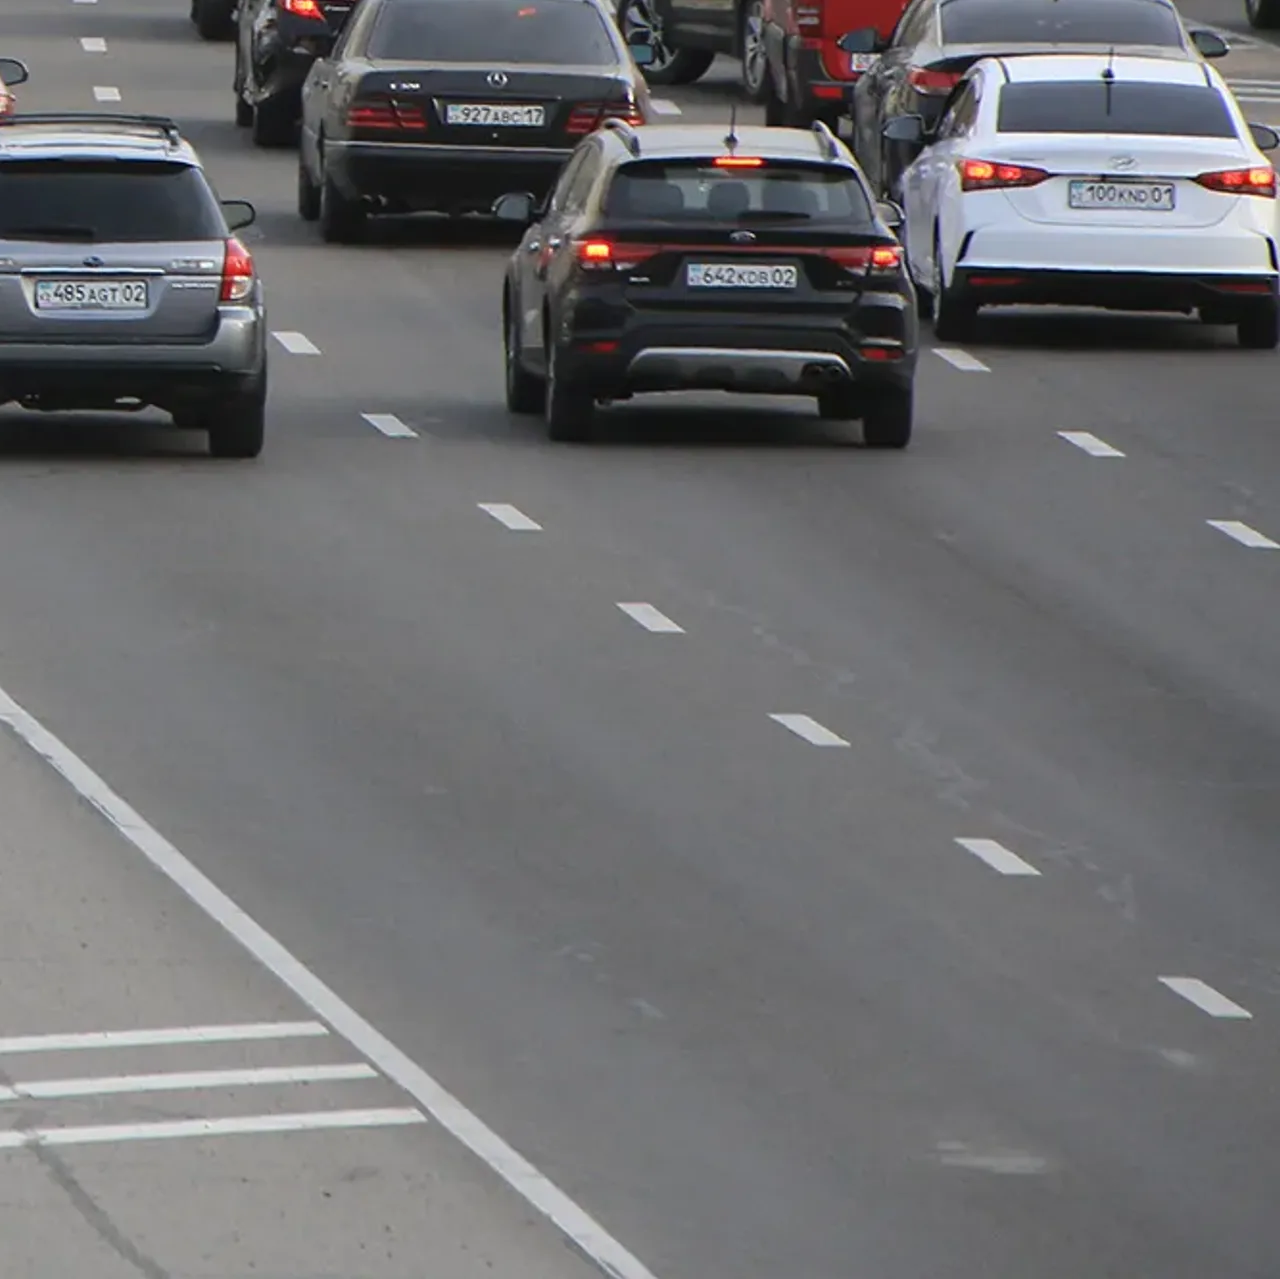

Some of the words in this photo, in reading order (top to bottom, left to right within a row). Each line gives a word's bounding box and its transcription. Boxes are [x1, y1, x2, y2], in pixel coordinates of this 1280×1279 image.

[461, 107, 490, 121] 927
[524, 107, 543, 123] 17
[1086, 185, 1116, 202] 100
[1151, 187, 1173, 203] 01
[702, 267, 735, 284] 642
[771, 268, 796, 286] 02
[53, 284, 85, 303] 485
[89, 287, 118, 303] AGT
[123, 284, 145, 302] 02
